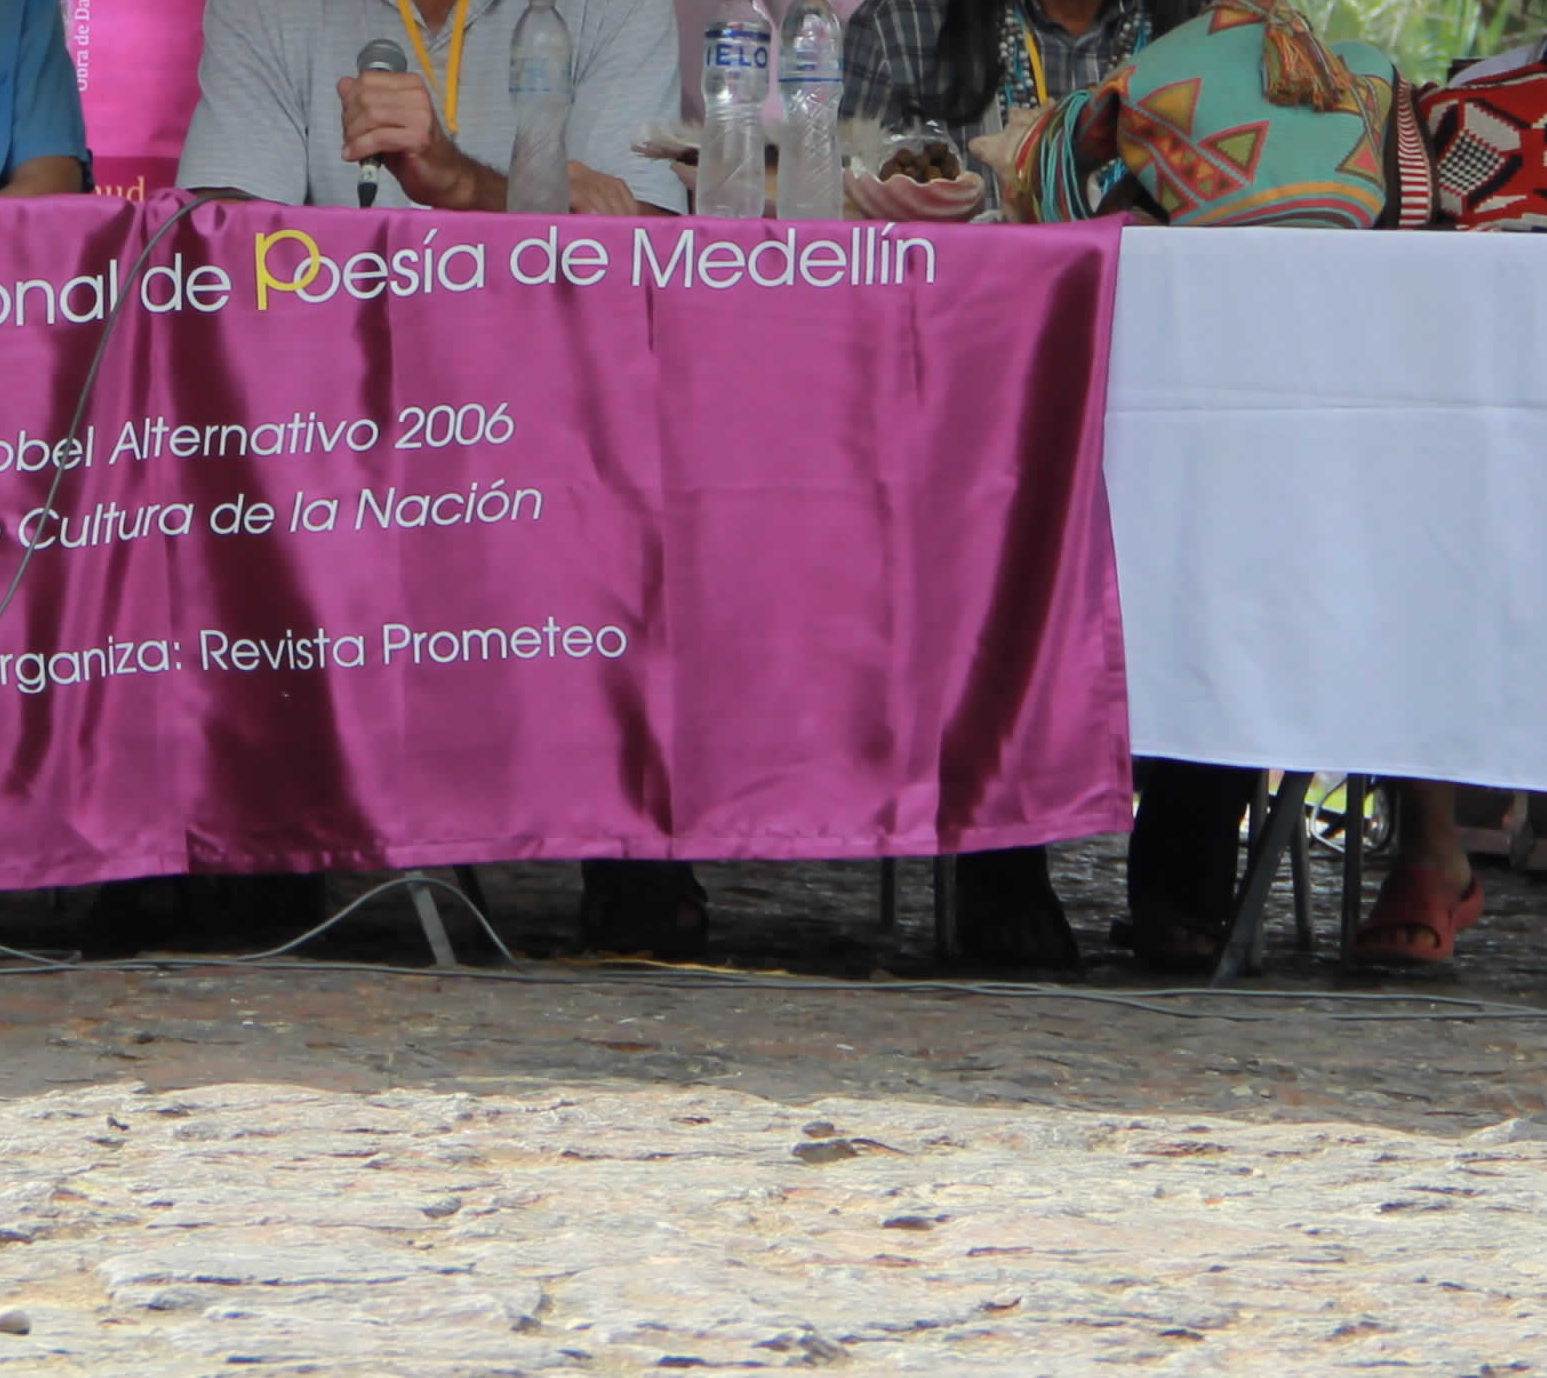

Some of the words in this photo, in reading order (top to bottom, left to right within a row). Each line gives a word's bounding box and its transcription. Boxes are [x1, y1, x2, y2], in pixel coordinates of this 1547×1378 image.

[75, 25, 90, 46] de
[141, 253, 232, 313] de
[509, 225, 609, 286] de
[632, 221, 935, 289] Medellín
[108, 410, 379, 465] Alternativo
[394, 402, 514, 449] 2006
[17, 501, 194, 550] Cultura
[210, 493, 275, 535] de
[290, 490, 339, 533] la
[354, 478, 542, 530] Nación
[200, 628, 365, 671] Revista
[383, 616, 627, 665] Prometeo
